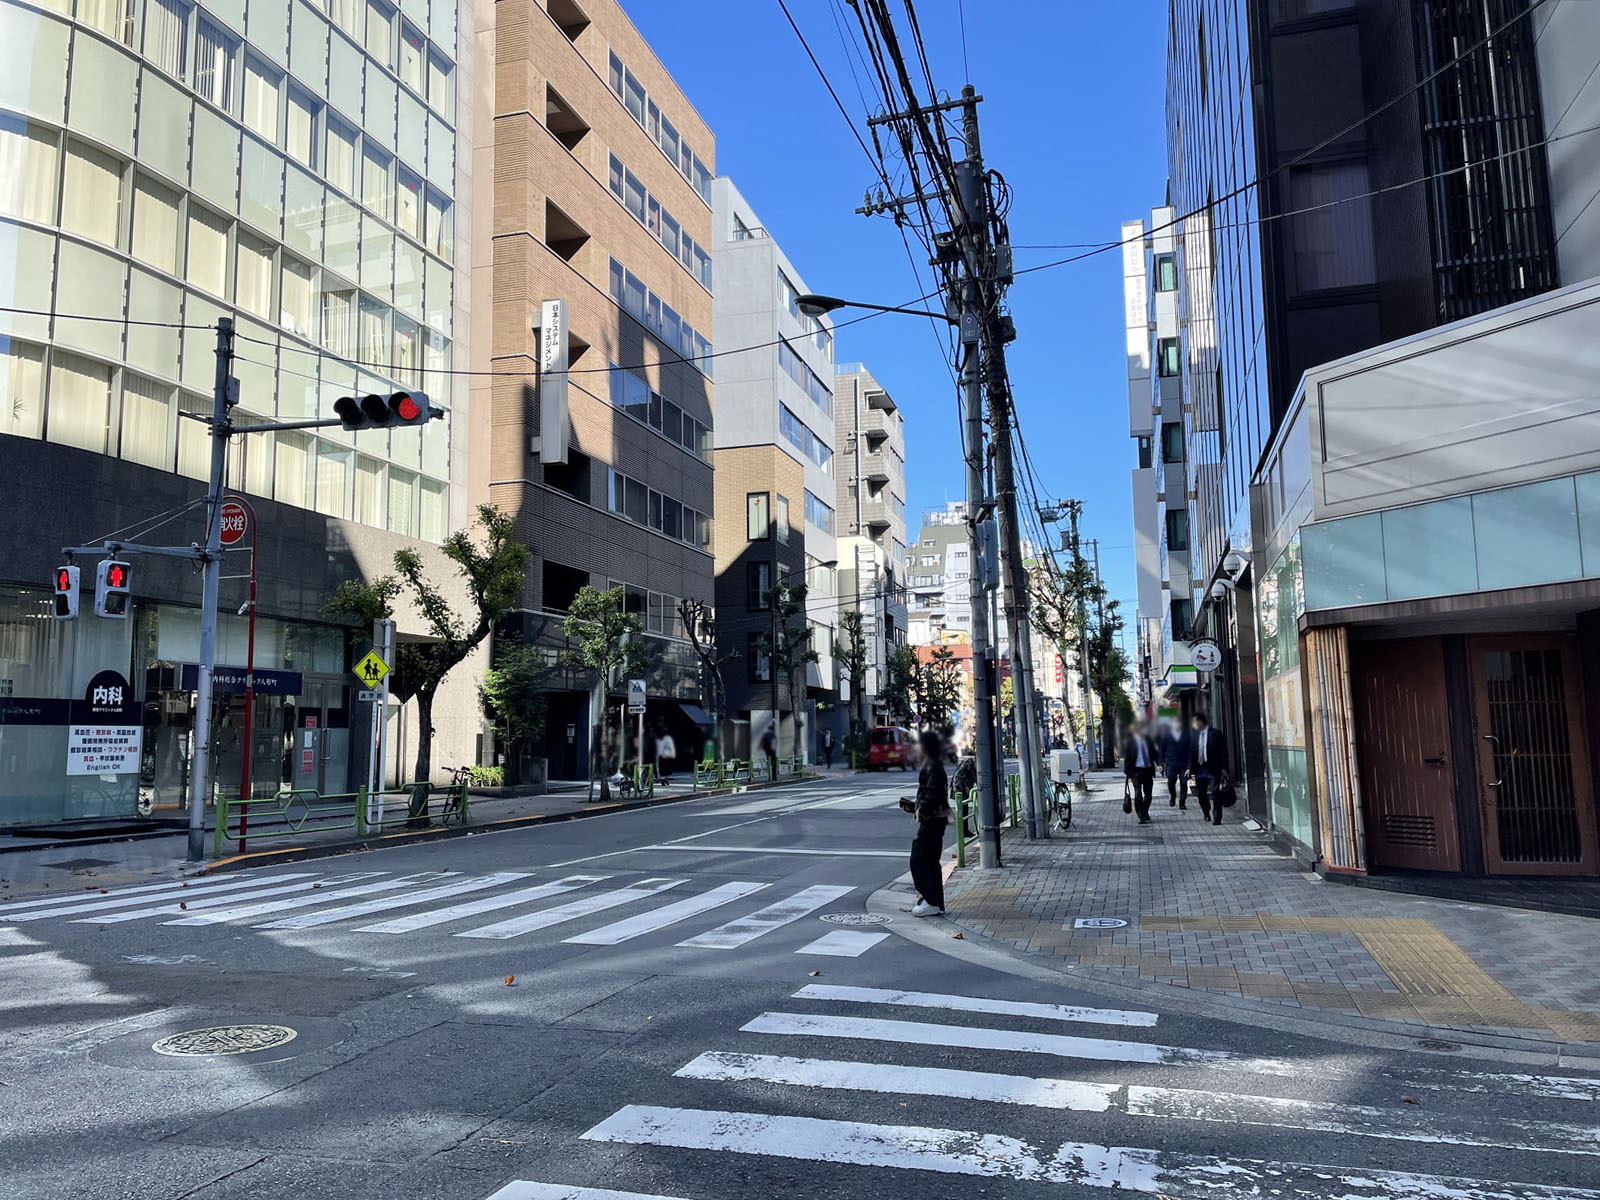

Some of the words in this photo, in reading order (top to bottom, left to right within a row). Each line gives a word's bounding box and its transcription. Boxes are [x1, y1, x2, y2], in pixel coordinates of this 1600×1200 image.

[213, 674, 278, 687] 内科総合クリック人形町
[93, 685, 123, 705] 内科
